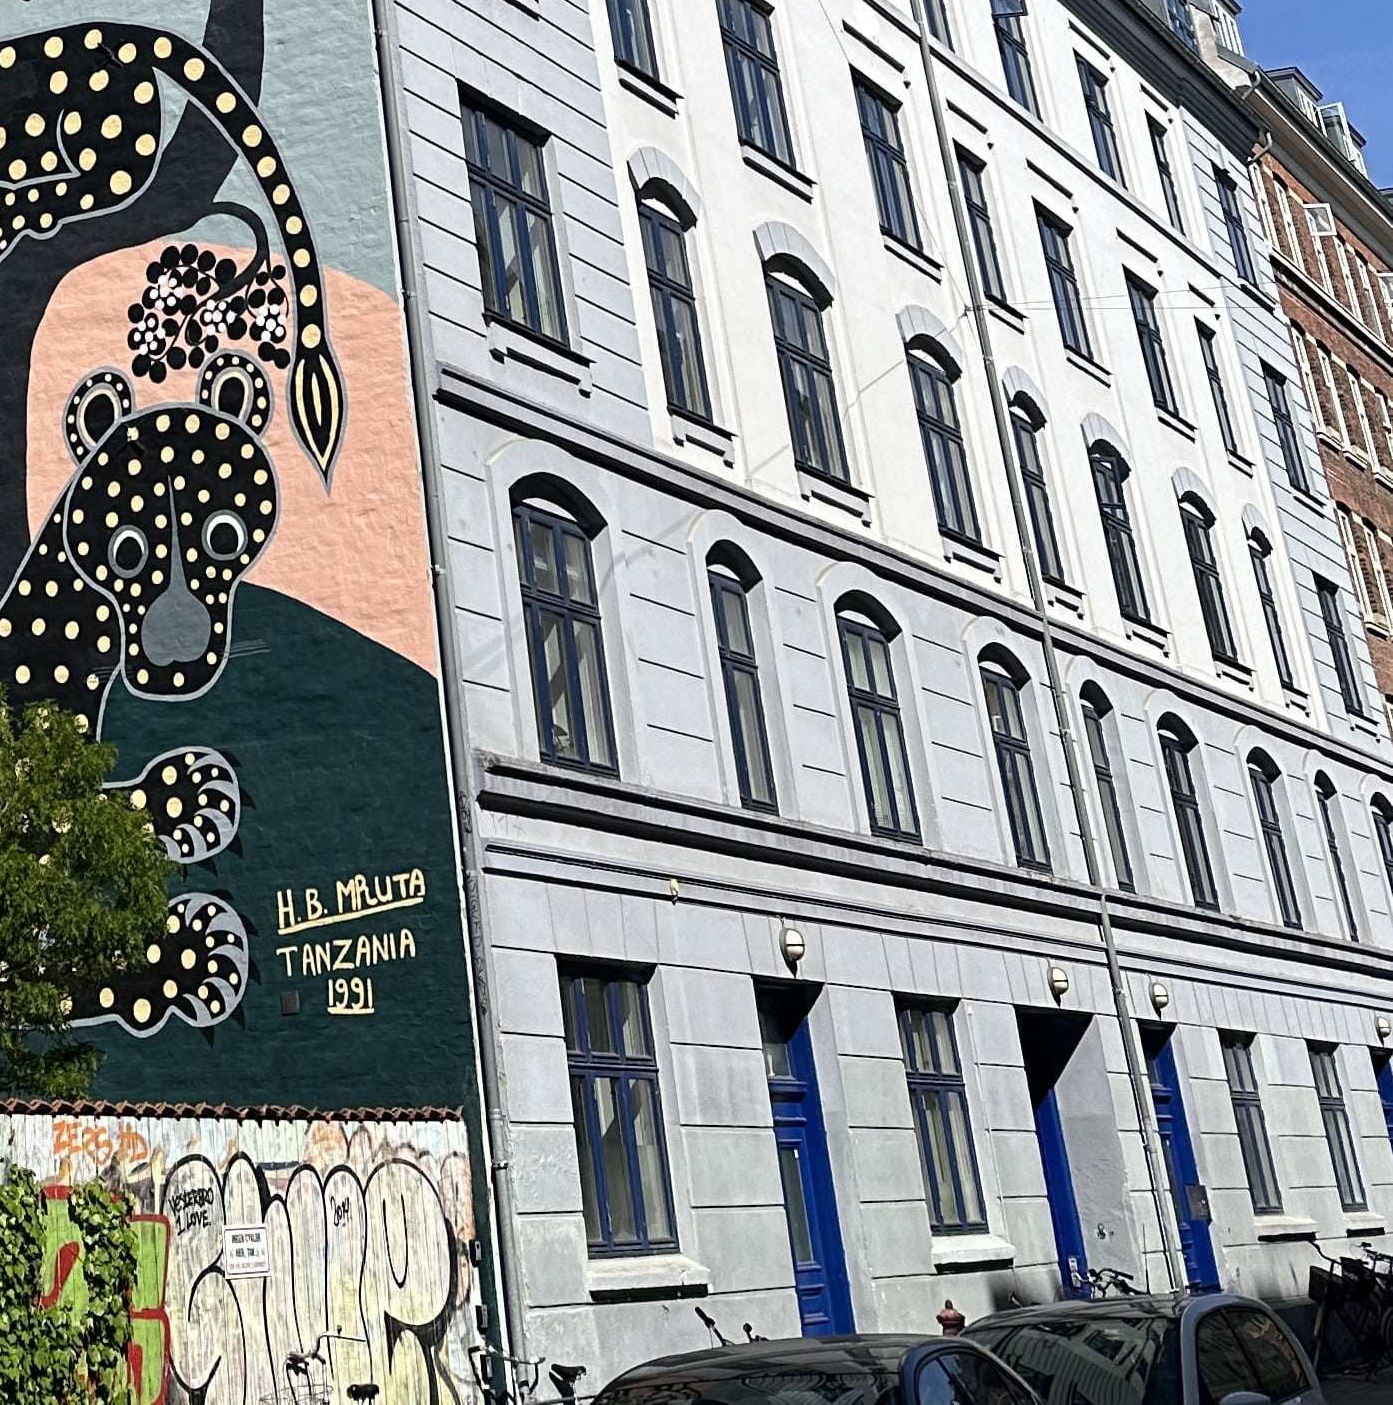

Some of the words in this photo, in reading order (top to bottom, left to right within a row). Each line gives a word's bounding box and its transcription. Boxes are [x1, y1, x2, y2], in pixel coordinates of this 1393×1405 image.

[276, 888, 328, 930] H.B.
[275, 928, 416, 977] TANZANIA
[327, 977, 373, 1010] 1991
